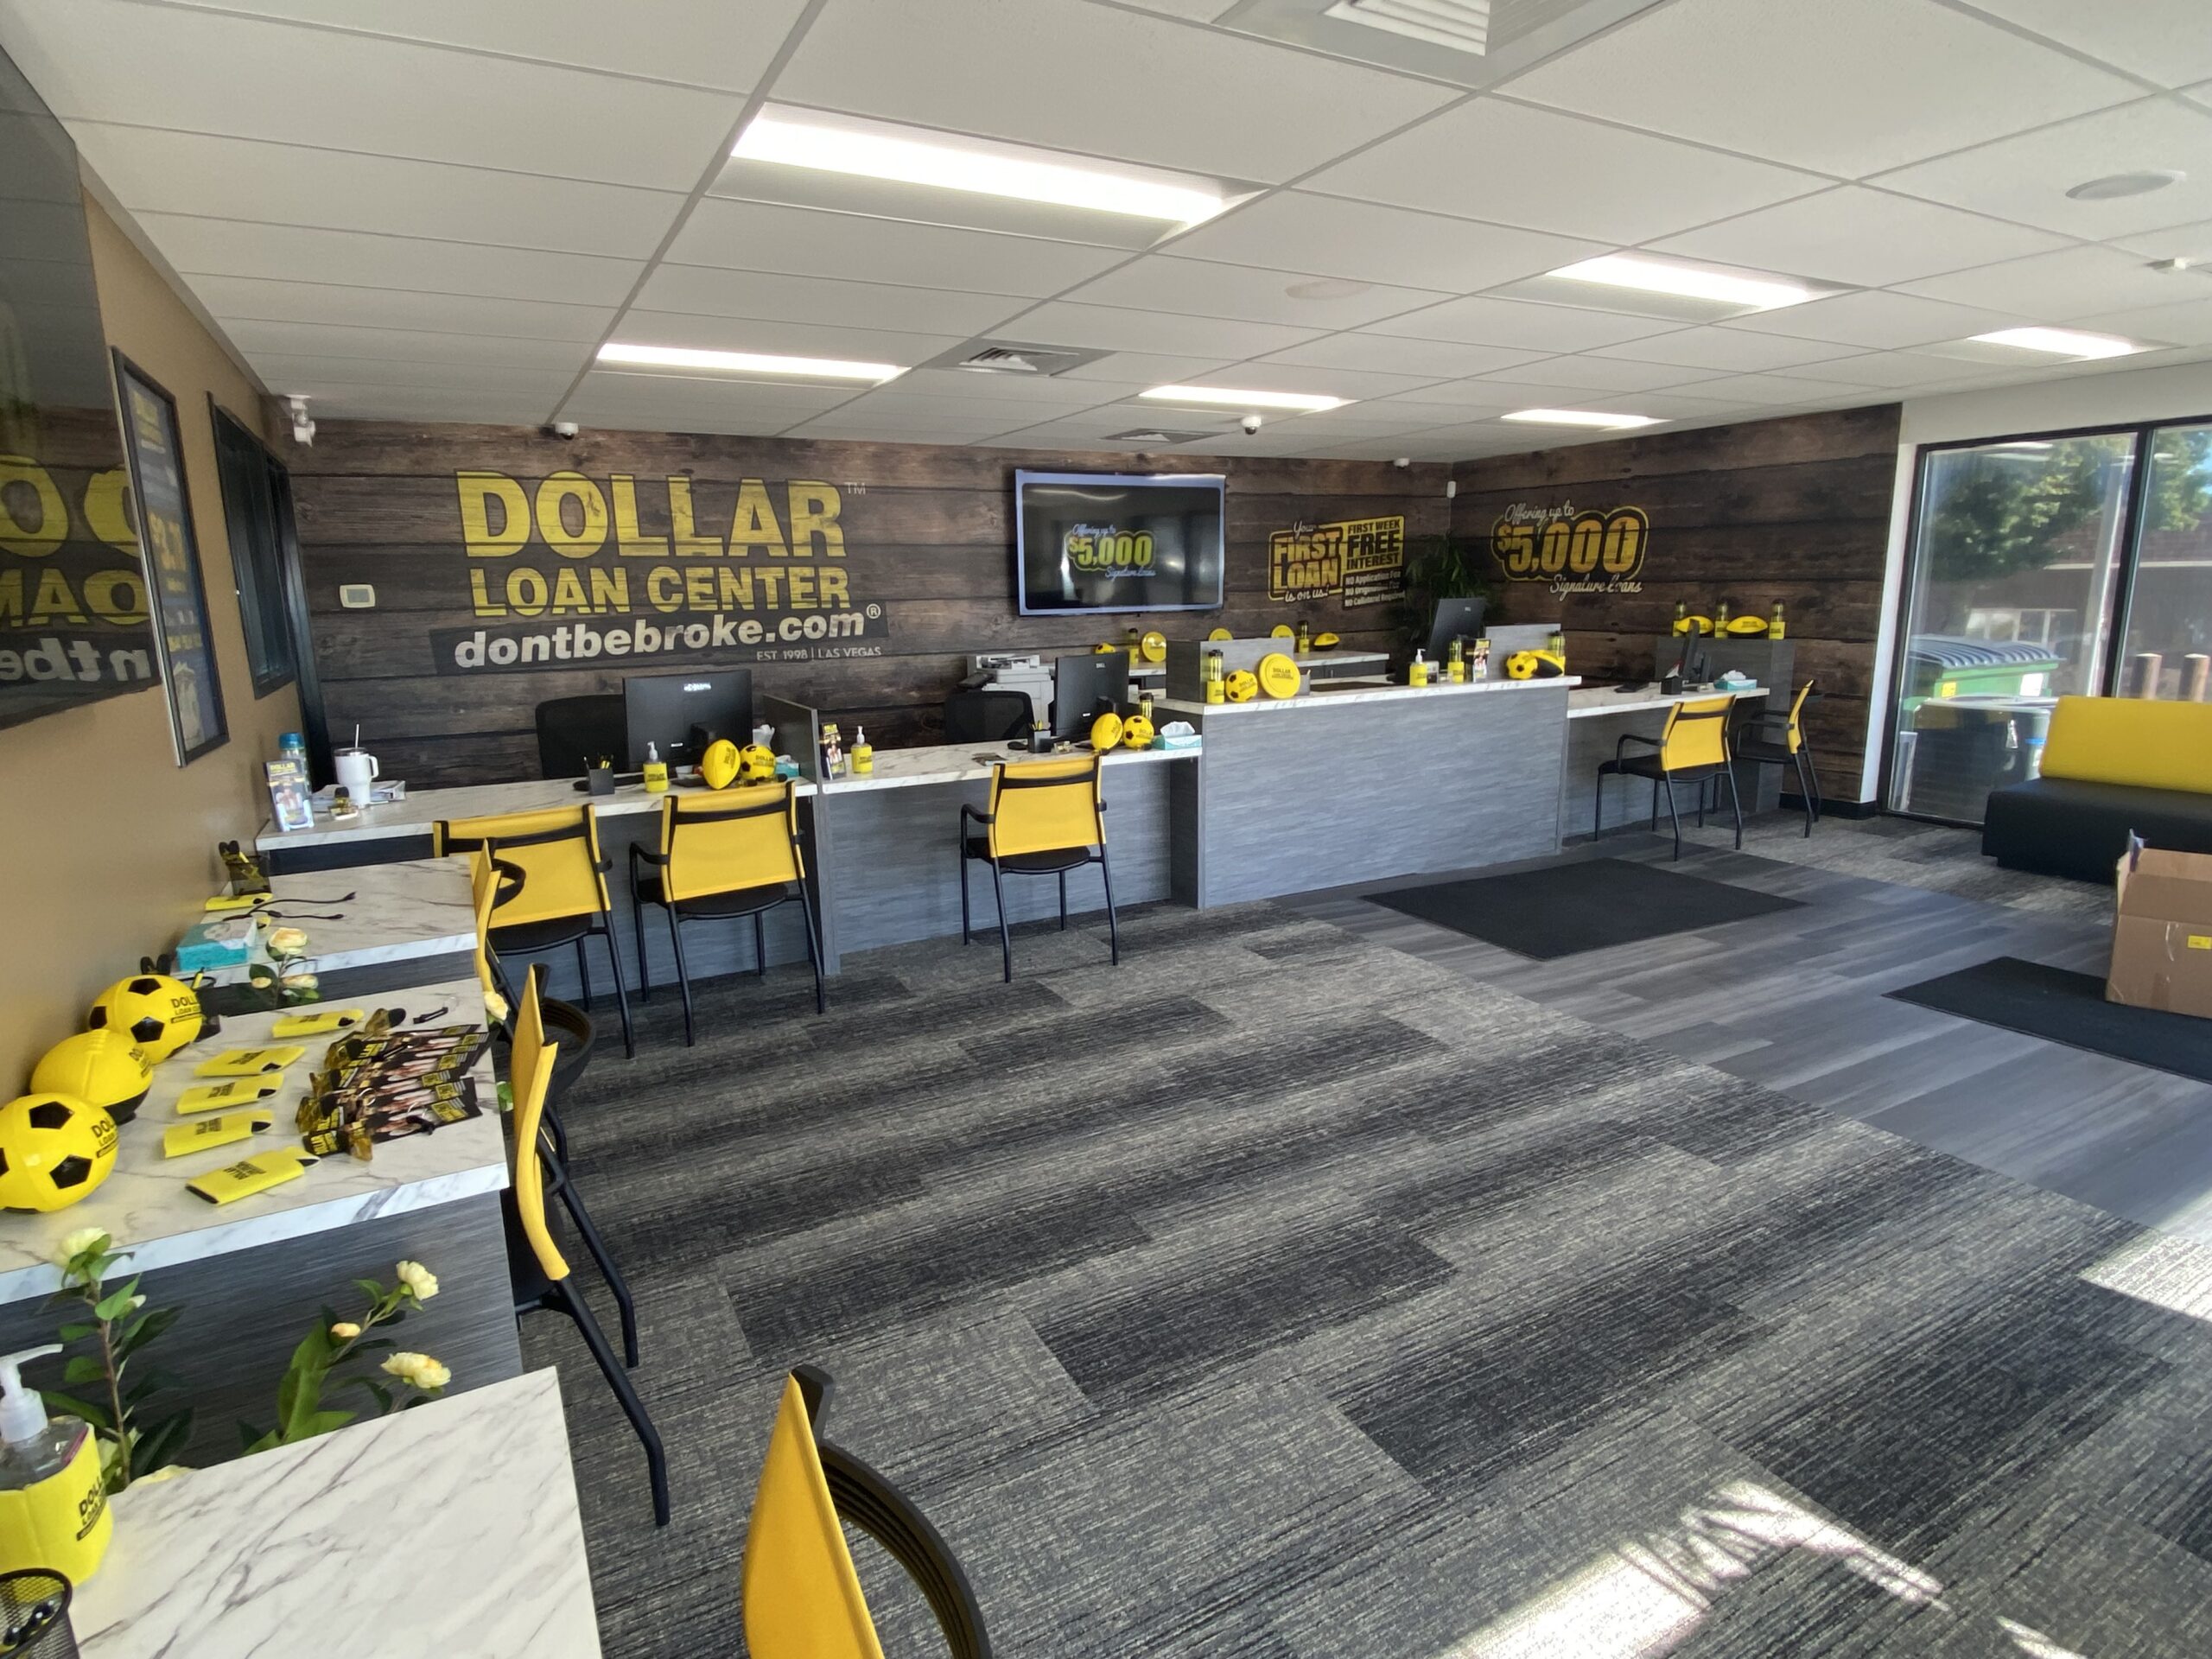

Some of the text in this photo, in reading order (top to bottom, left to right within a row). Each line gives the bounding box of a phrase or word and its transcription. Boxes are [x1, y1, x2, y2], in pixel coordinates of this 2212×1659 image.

[456, 469, 848, 558] DOLLAR
[1504, 499, 1574, 525] Offering up to
[1348, 519, 1400, 535] FIRST WEEK
[1069, 536, 1152, 566] $5,000
[1274, 531, 1339, 564] FIRST
[1348, 530, 1400, 557] FREE
[1497, 516, 1640, 574] $5,000
[1347, 552, 1400, 570] INTEREST
[1274, 558, 1338, 592] LOAN
[1549, 574, 1608, 601] Signature
[470, 566, 851, 616] LOAN CENTER
[1285, 589, 1295, 602] is
[1297, 589, 1311, 600] on
[756, 646, 881, 661] EST 1998 LAS VEGAS
